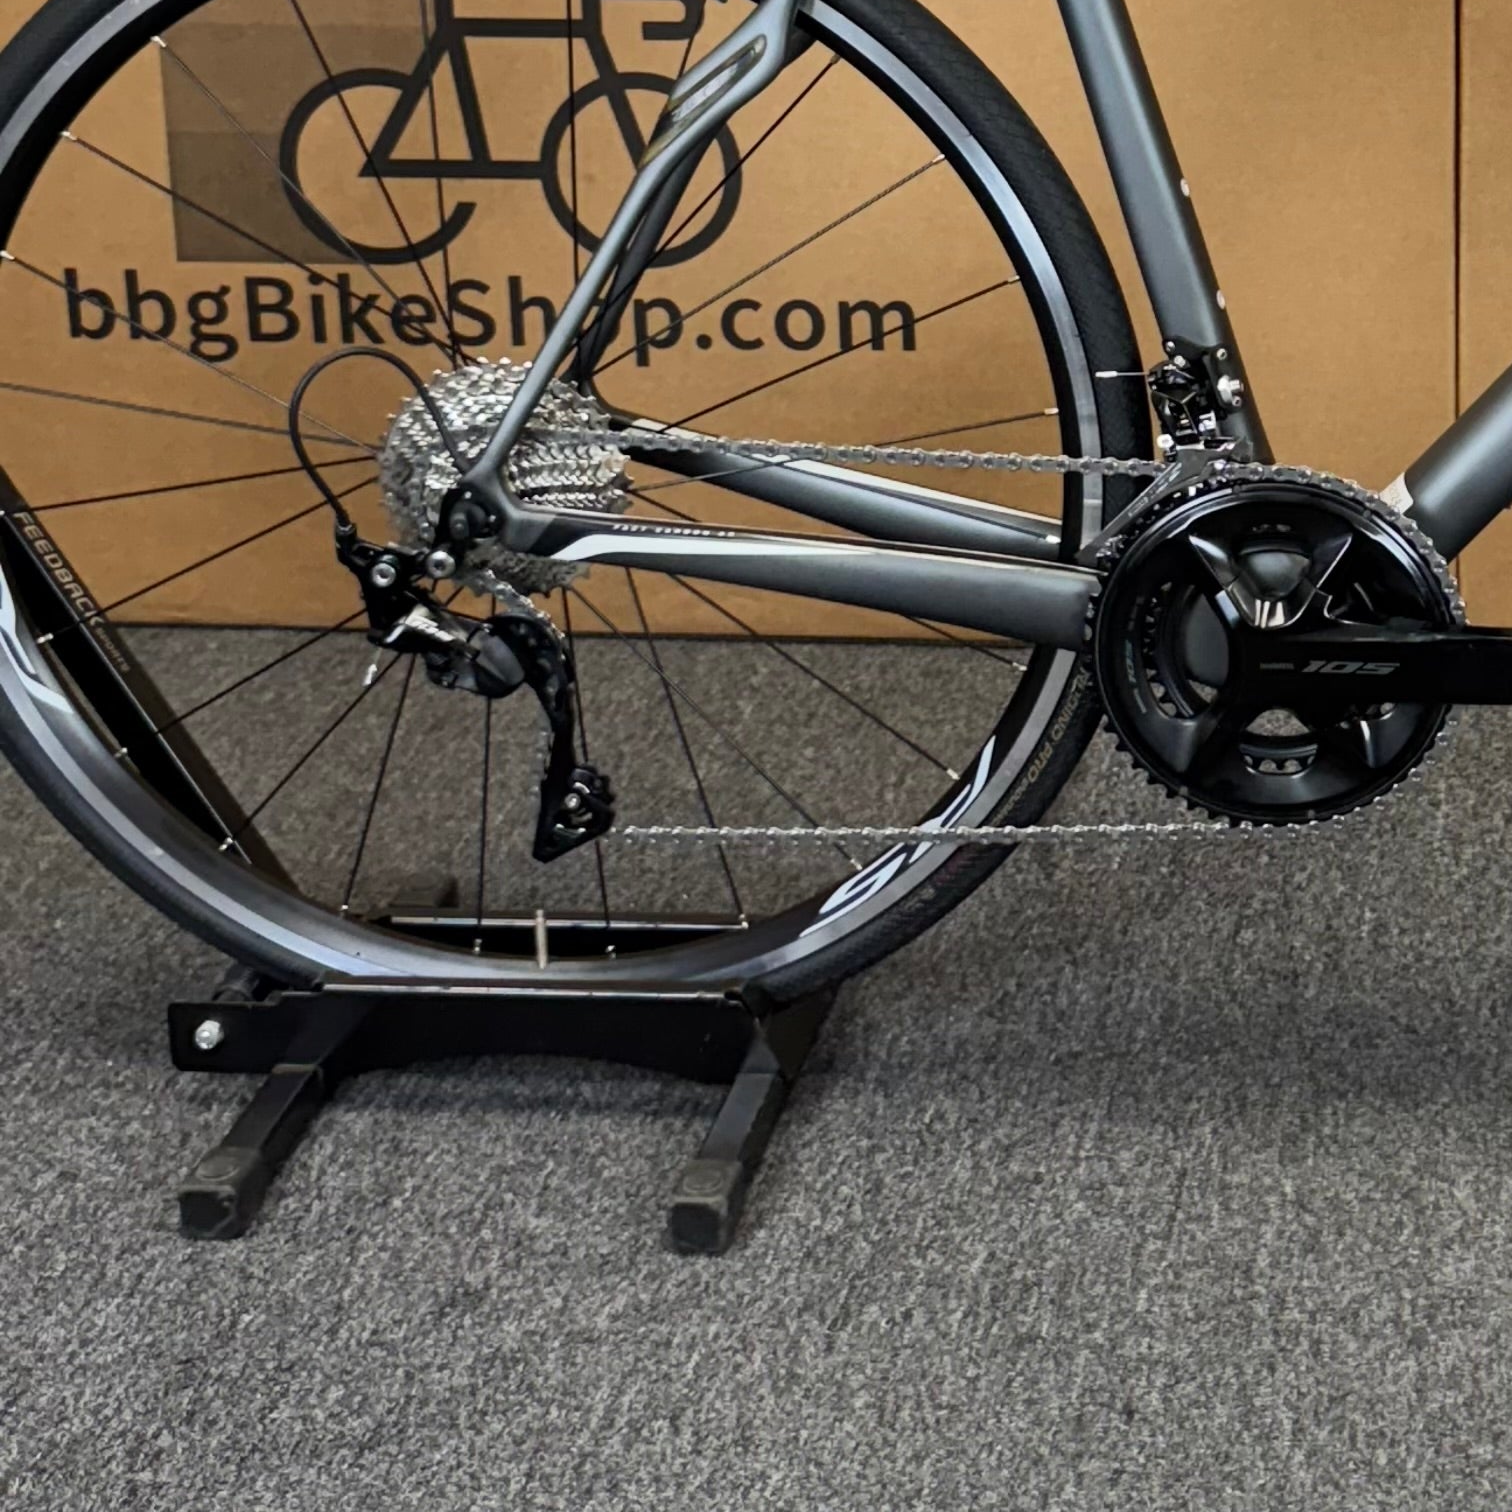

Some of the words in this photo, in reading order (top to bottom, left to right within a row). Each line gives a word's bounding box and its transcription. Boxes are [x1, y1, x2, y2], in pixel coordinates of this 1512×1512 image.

[64, 268, 918, 368] bbgBikeShp.com
[13, 511, 105, 626] FEEDBACK
[1301, 659, 1401, 676] 105
